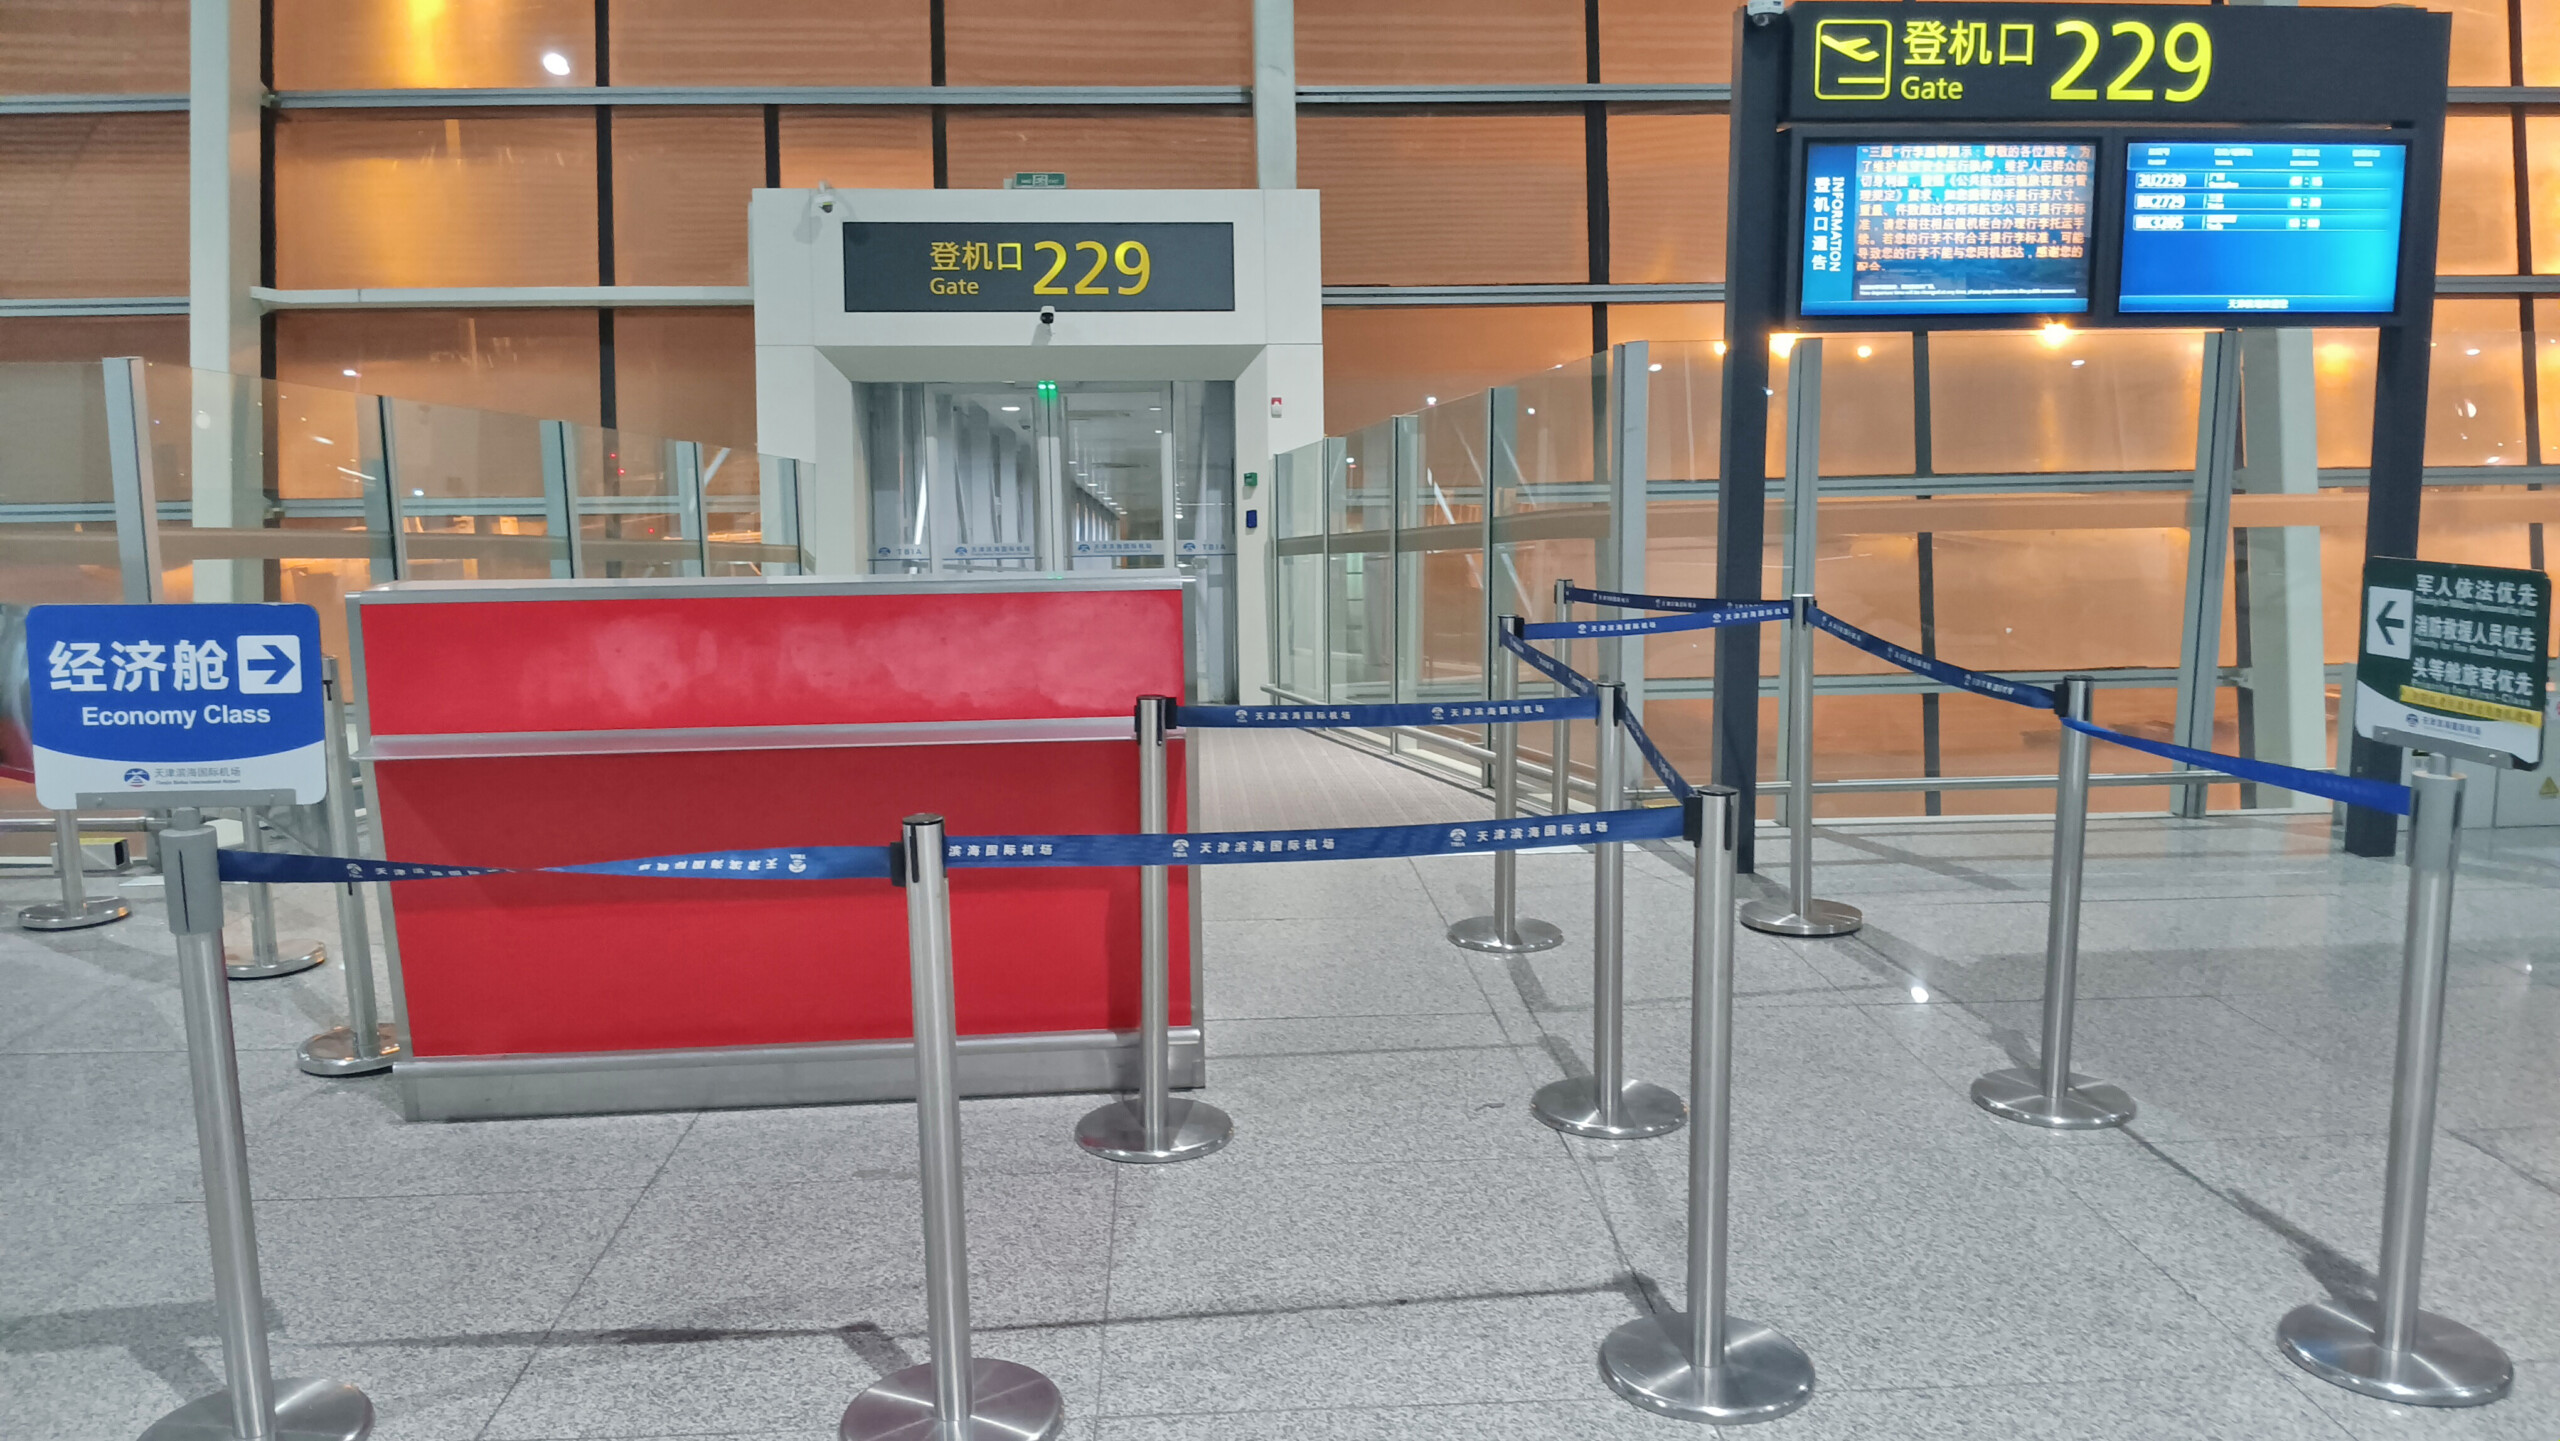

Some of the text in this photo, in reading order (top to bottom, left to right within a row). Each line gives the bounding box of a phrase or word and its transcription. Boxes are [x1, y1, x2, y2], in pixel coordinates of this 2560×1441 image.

[1902, 20, 2213, 103] 登机口 229
[1900, 77, 1964, 101] Gate
[1829, 176, 1845, 272] INFORMATION
[929, 240, 1151, 296] 登机口 229
[929, 277, 980, 296] Gate
[2415, 574, 2539, 607] 军人依法优先
[48, 639, 230, 692] 经济舱
[82, 704, 271, 730] Economy Class
[154, 766, 241, 778] 天津滨海国际机场
[1476, 821, 1609, 843] 天津滨海国际机场
[1200, 838, 1335, 854] 天津滨海国际机场
